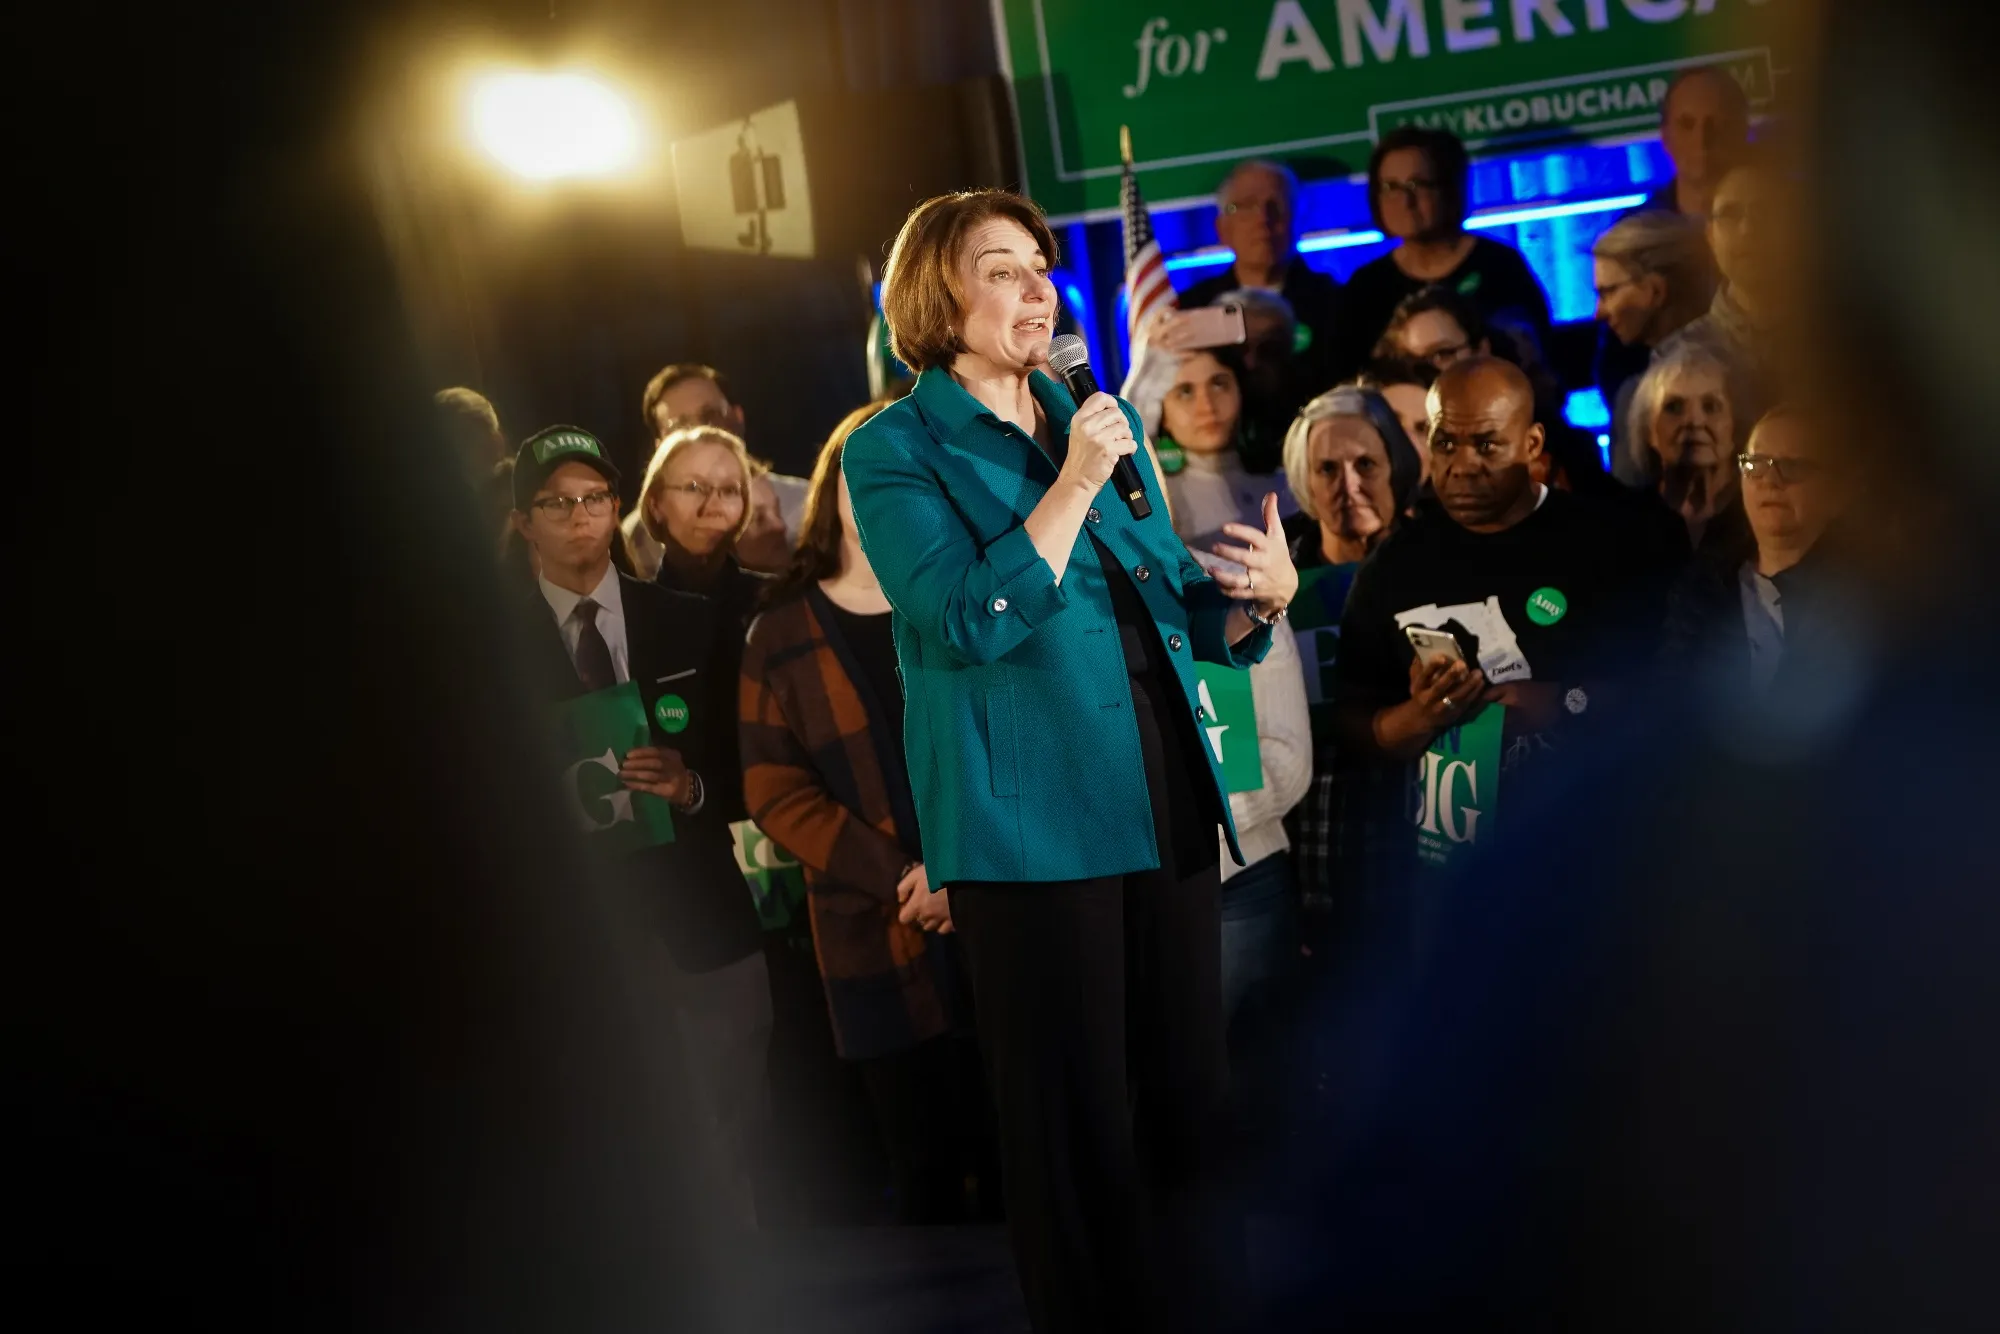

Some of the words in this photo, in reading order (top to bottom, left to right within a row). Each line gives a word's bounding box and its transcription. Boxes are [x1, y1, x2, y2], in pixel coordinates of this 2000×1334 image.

[1122, 16, 1228, 98] for
[1255, 0, 1771, 81] AMER
[542, 435, 592, 459] Amy
[1531, 593, 1564, 617] Amy
[658, 706, 686, 721] Amy
[1404, 750, 1482, 846] BIG
